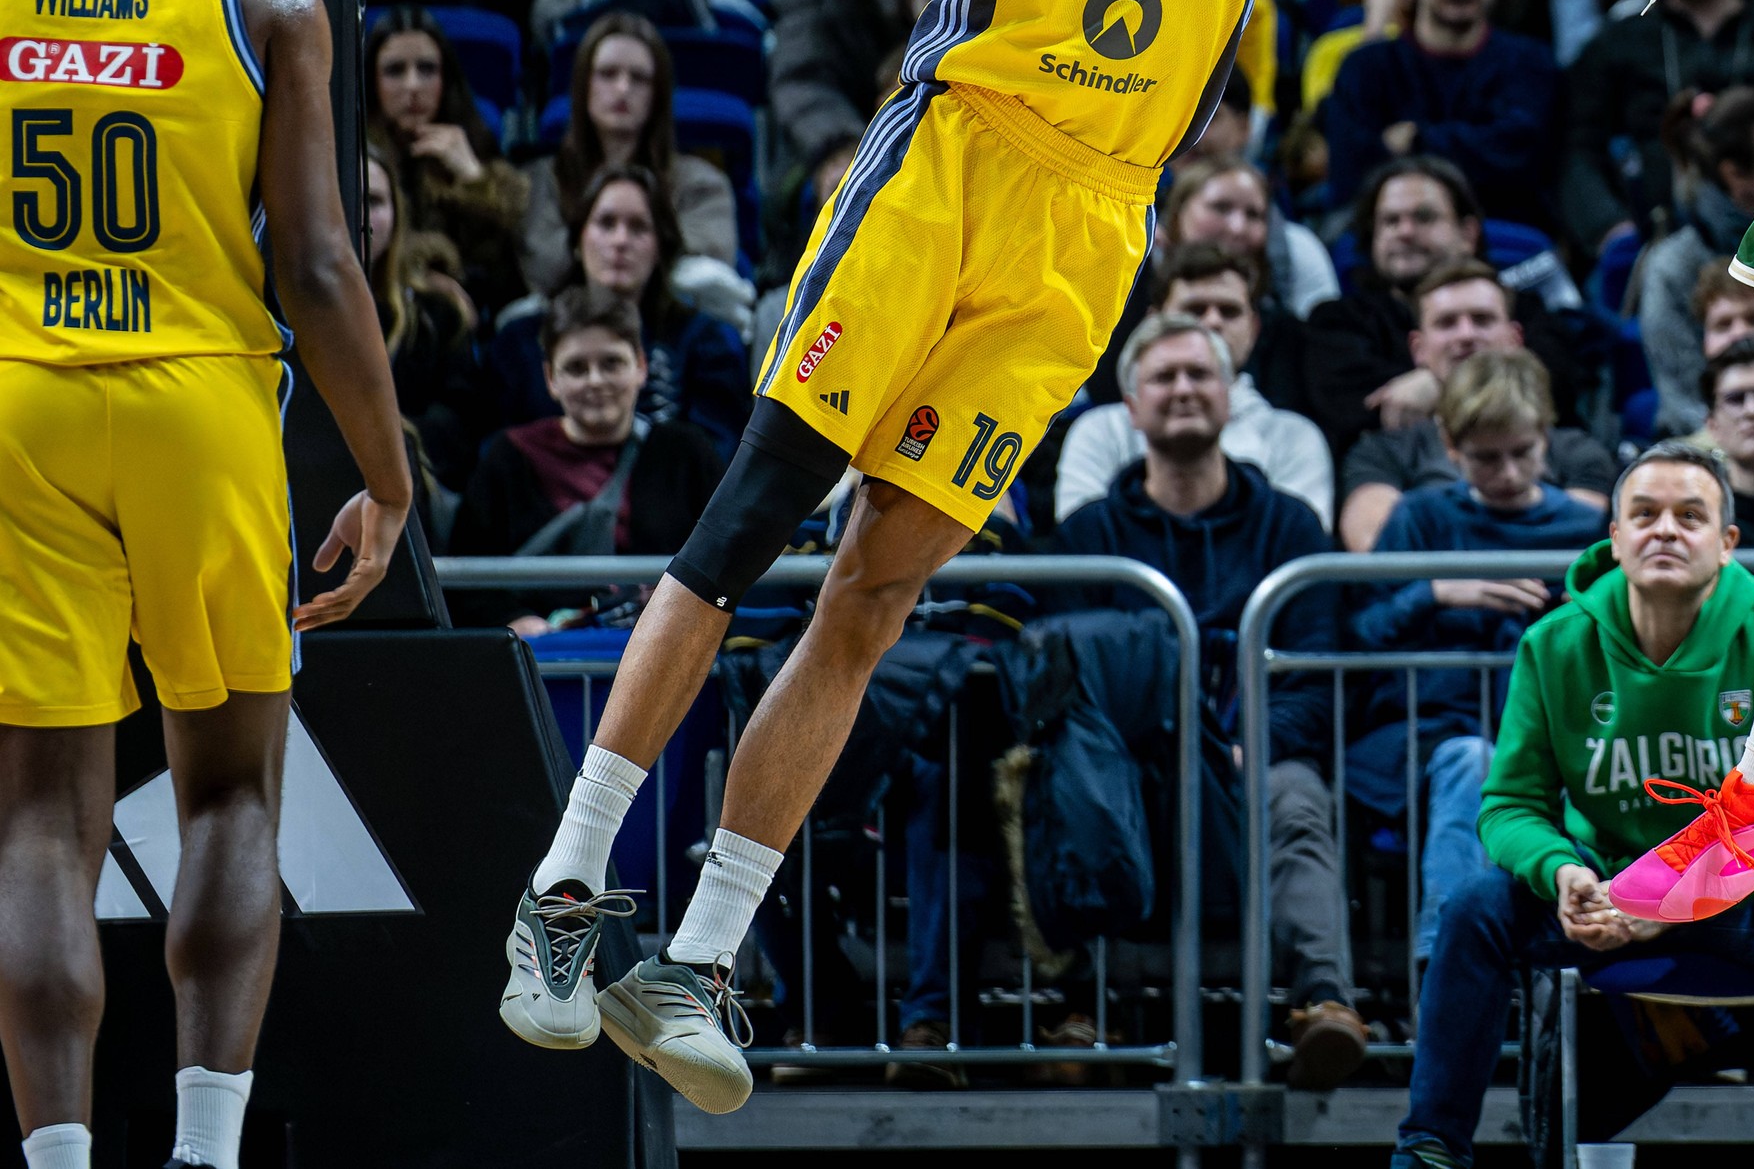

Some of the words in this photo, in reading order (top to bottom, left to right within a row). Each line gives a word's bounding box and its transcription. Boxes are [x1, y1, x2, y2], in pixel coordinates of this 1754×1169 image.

[1039, 53, 1158, 95] Schindler
[12, 108, 161, 253] 50
[42, 269, 151, 333] BERLIN
[951, 412, 1022, 500] 19
